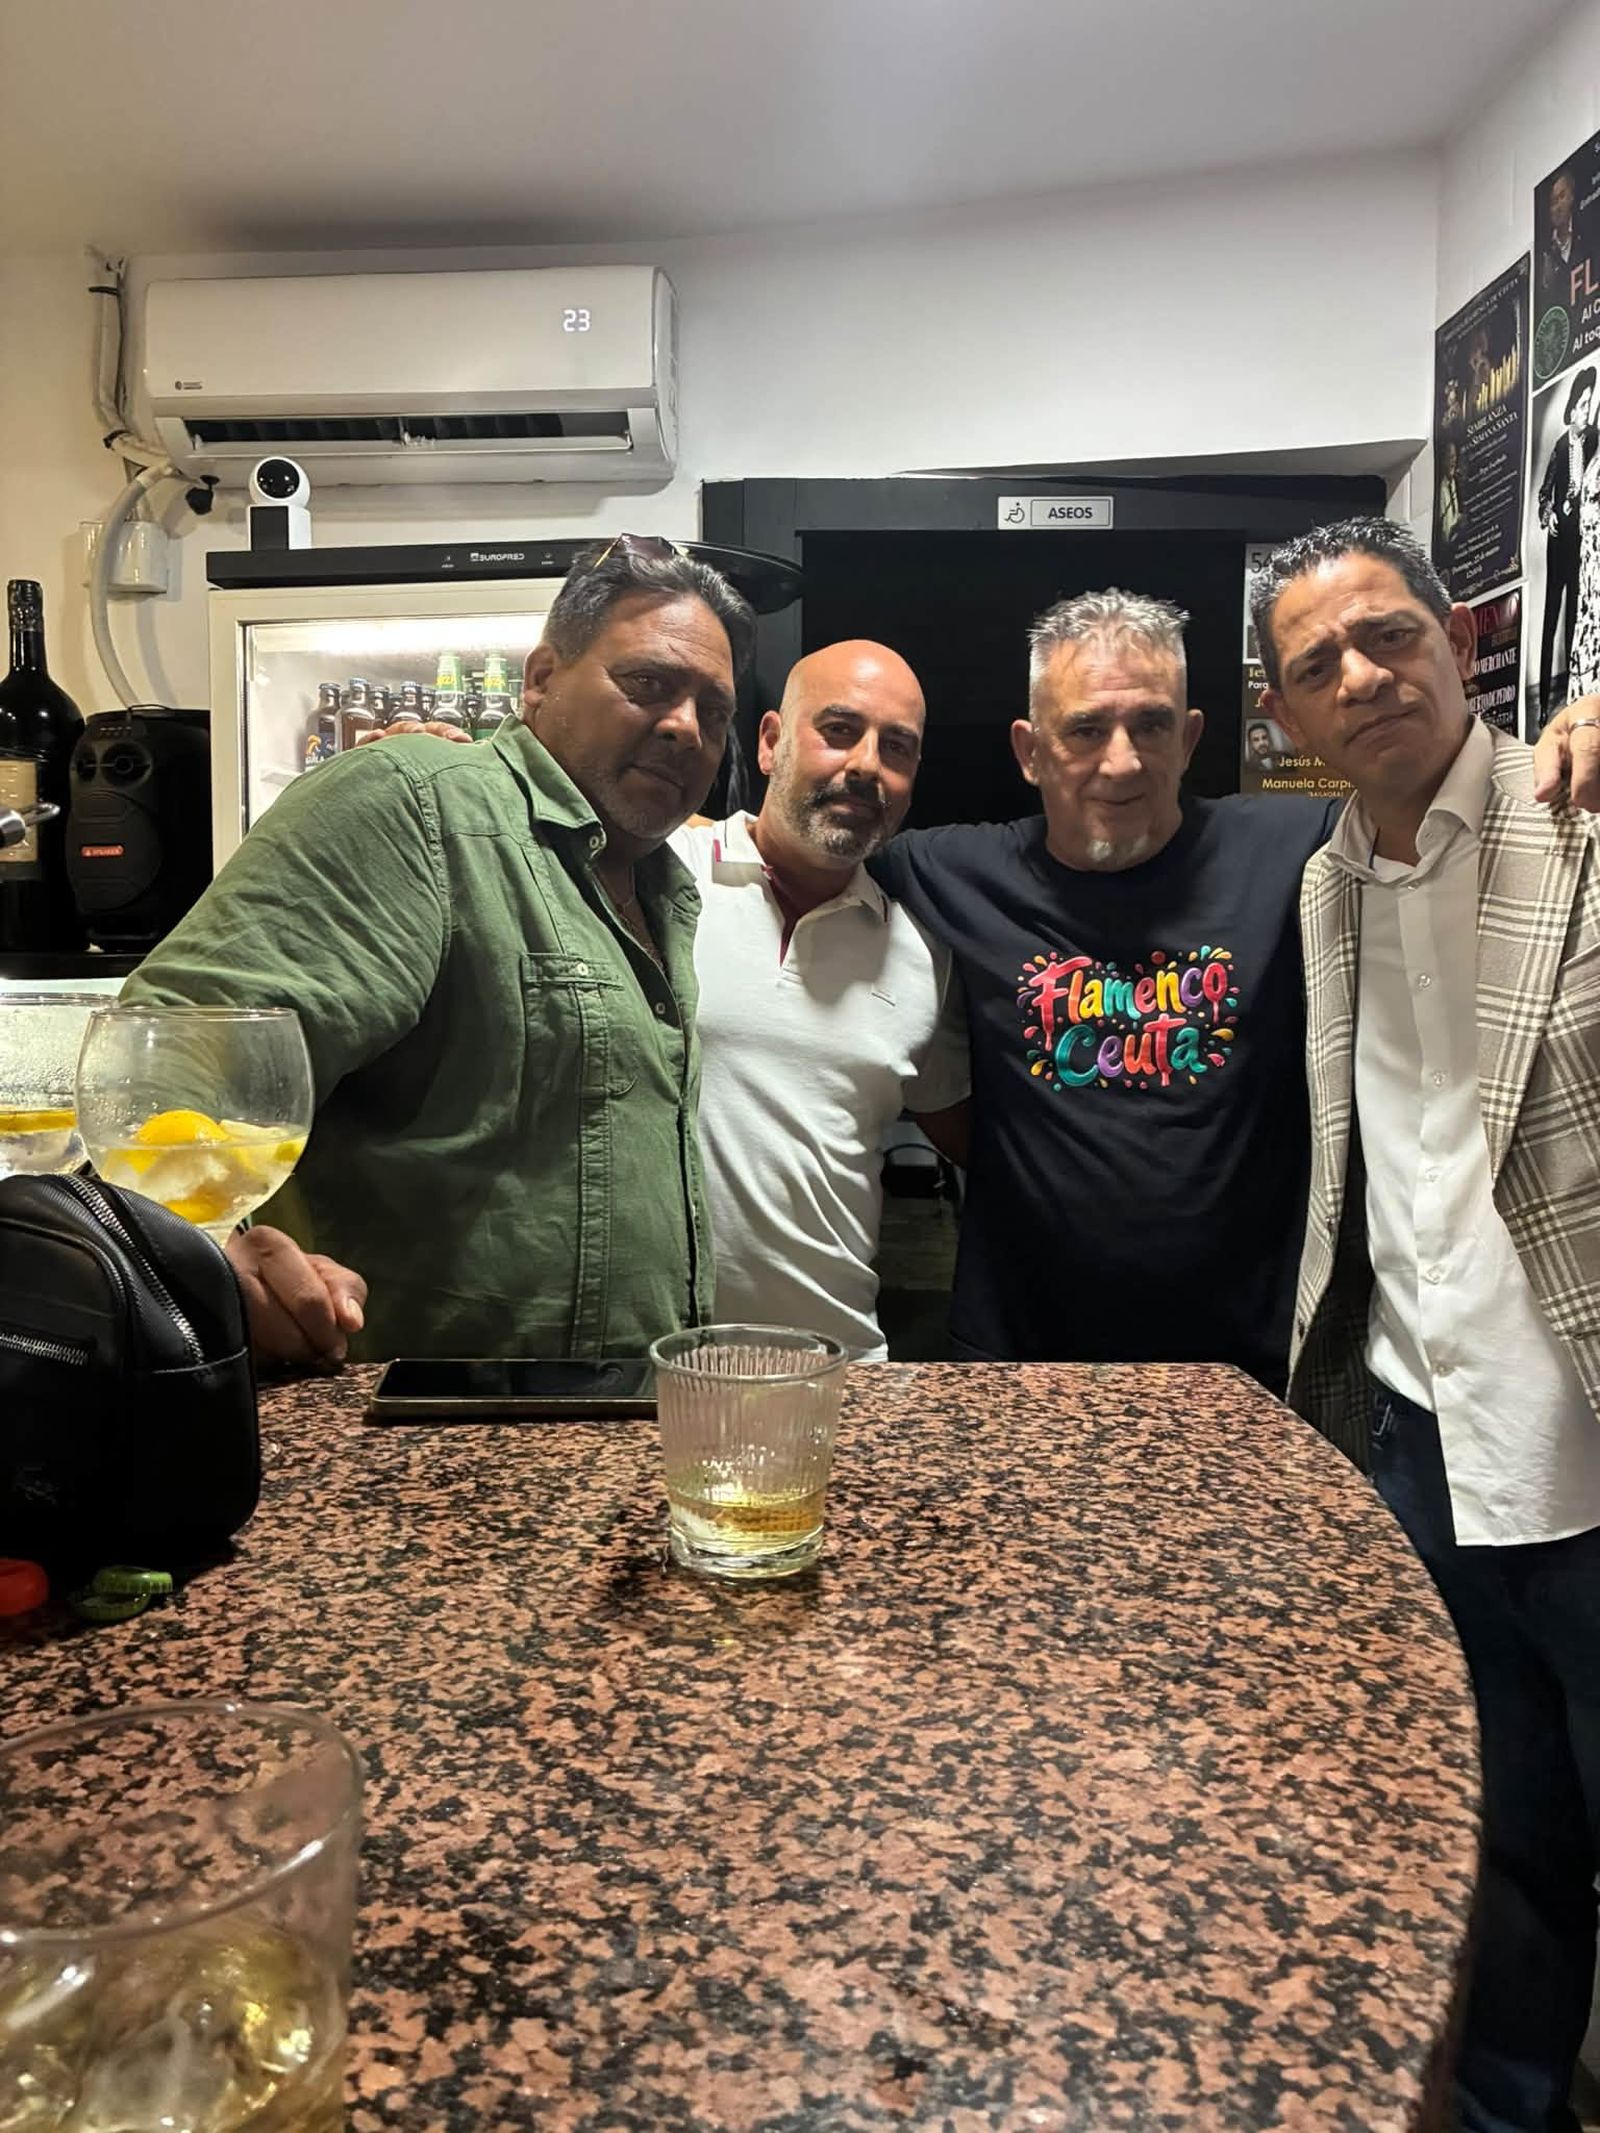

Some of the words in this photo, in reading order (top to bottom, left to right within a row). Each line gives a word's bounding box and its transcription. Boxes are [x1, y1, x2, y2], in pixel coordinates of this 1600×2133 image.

[563, 308, 590, 332] 23
[1048, 507, 1093, 519] ASEOS
[1279, 755, 1311, 767] Jesús
[1262, 778, 1315, 789] Manuela
[1028, 955, 1229, 1052] Flamenco
[1055, 1013, 1208, 1087] Ceuta
